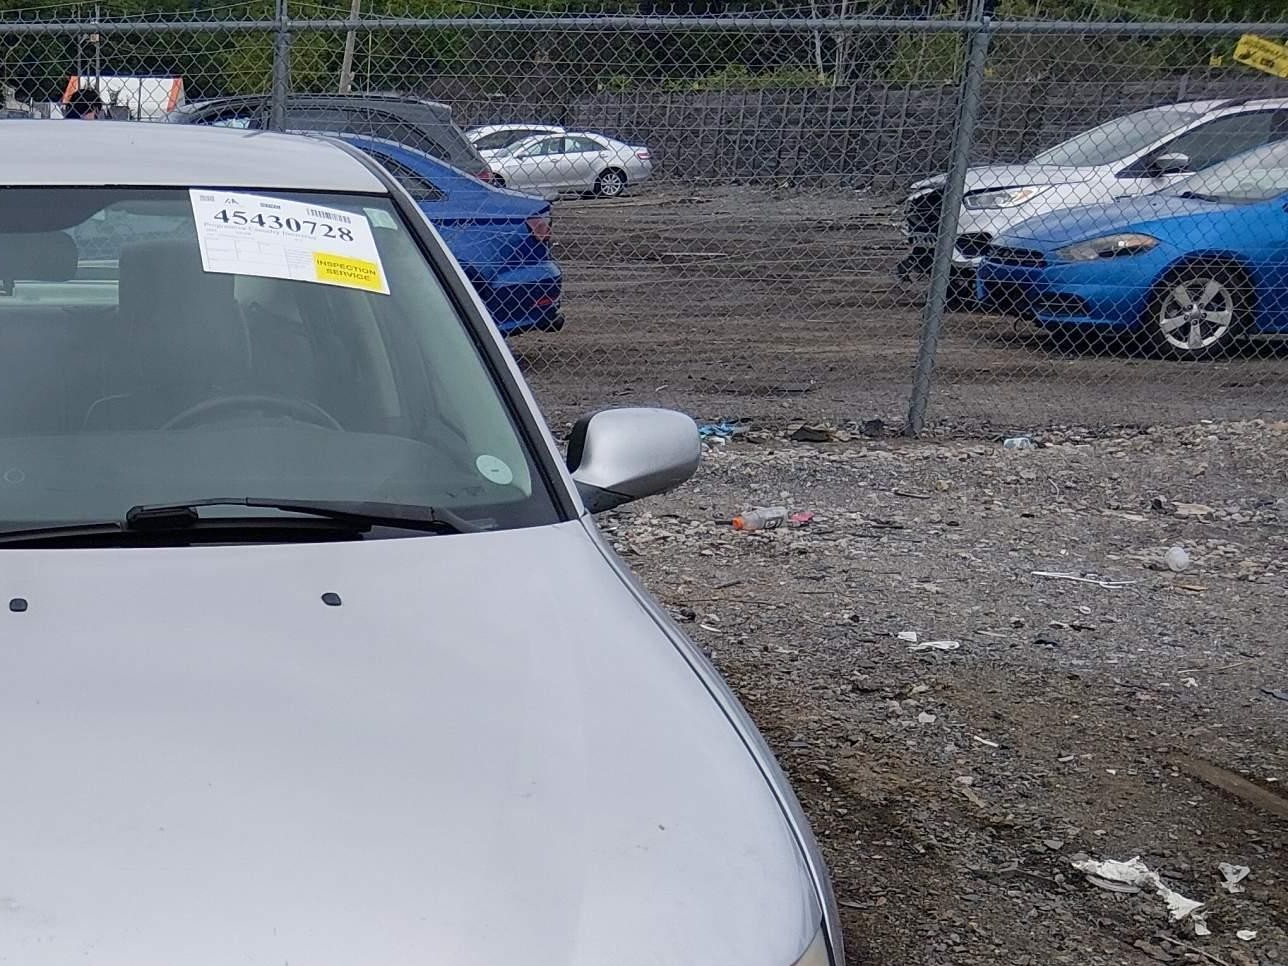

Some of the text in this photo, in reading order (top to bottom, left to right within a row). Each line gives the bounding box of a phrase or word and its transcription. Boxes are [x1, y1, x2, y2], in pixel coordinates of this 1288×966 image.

[214, 208, 354, 242] 45430728
[316, 259, 377, 276] INSPECTION
[325, 268, 371, 282] SERVICE
